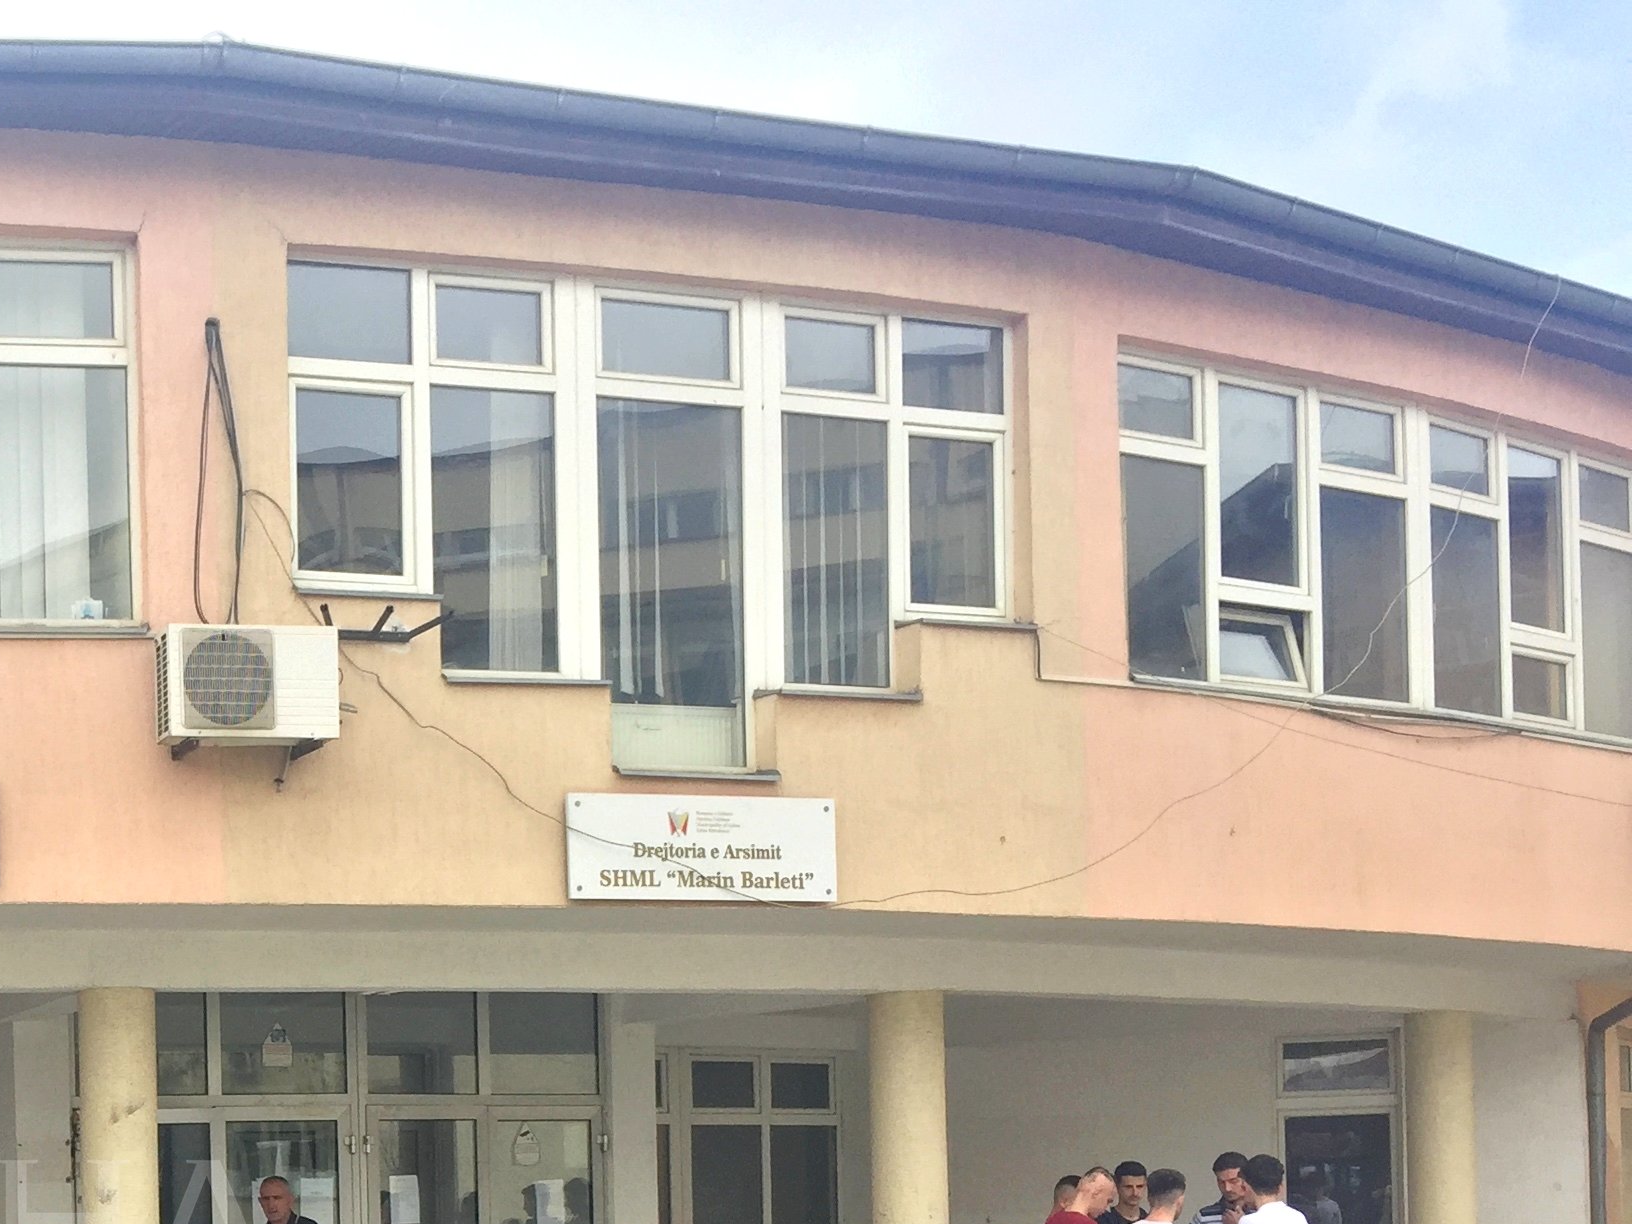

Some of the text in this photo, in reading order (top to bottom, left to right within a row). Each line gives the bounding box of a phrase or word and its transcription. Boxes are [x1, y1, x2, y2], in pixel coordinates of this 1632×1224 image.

[633, 842, 782, 862] Drejtoria e Arsimit
[599, 870, 661, 888] SHML
[741, 871, 814, 890] Barleti”
